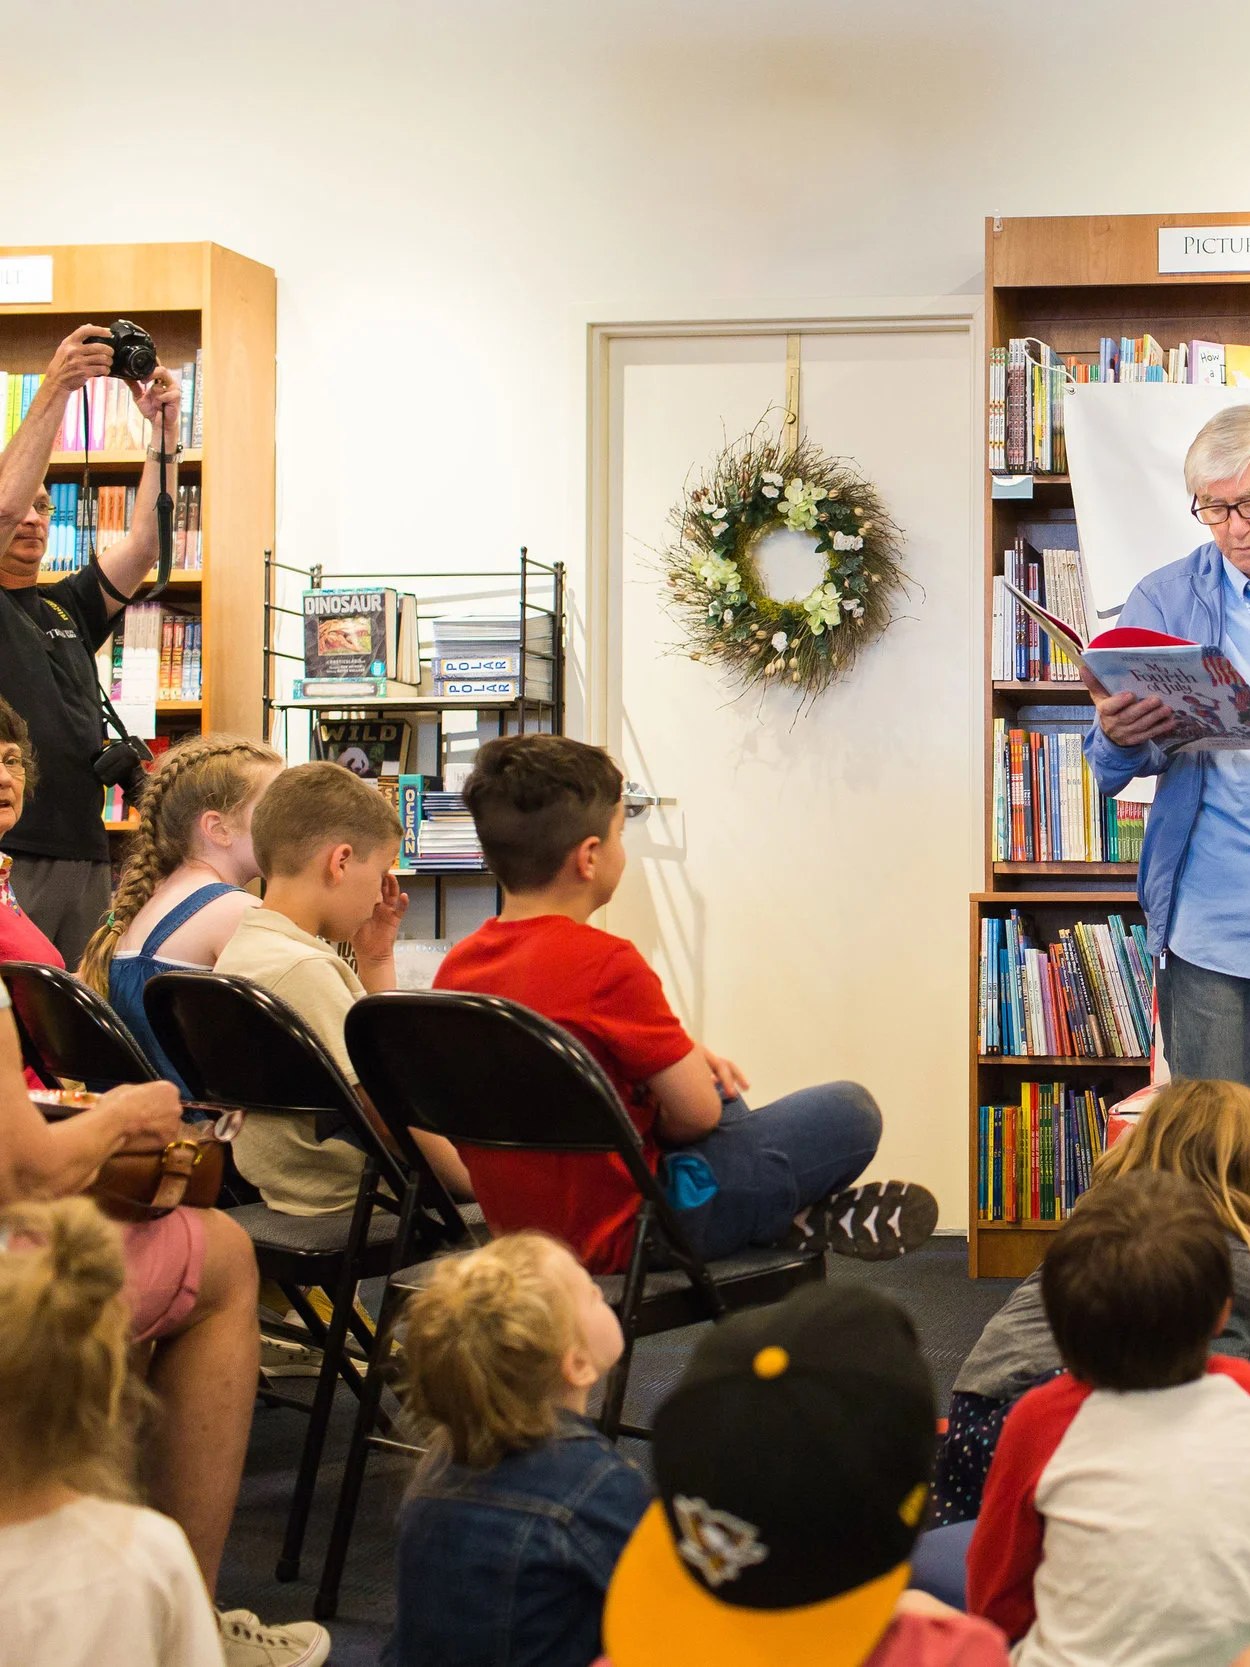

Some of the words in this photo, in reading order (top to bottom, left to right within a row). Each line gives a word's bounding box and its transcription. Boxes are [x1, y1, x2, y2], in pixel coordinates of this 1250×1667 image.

[304, 594, 382, 615] DINOSAUR
[446, 660, 507, 671] POLAR
[1145, 663, 1169, 674] My
[1128, 668, 1197, 684] Fourth
[449, 683, 510, 693] POLAR
[1160, 682, 1193, 695] July
[321, 724, 397, 741] WILD
[404, 788, 416, 854] OCEAN
